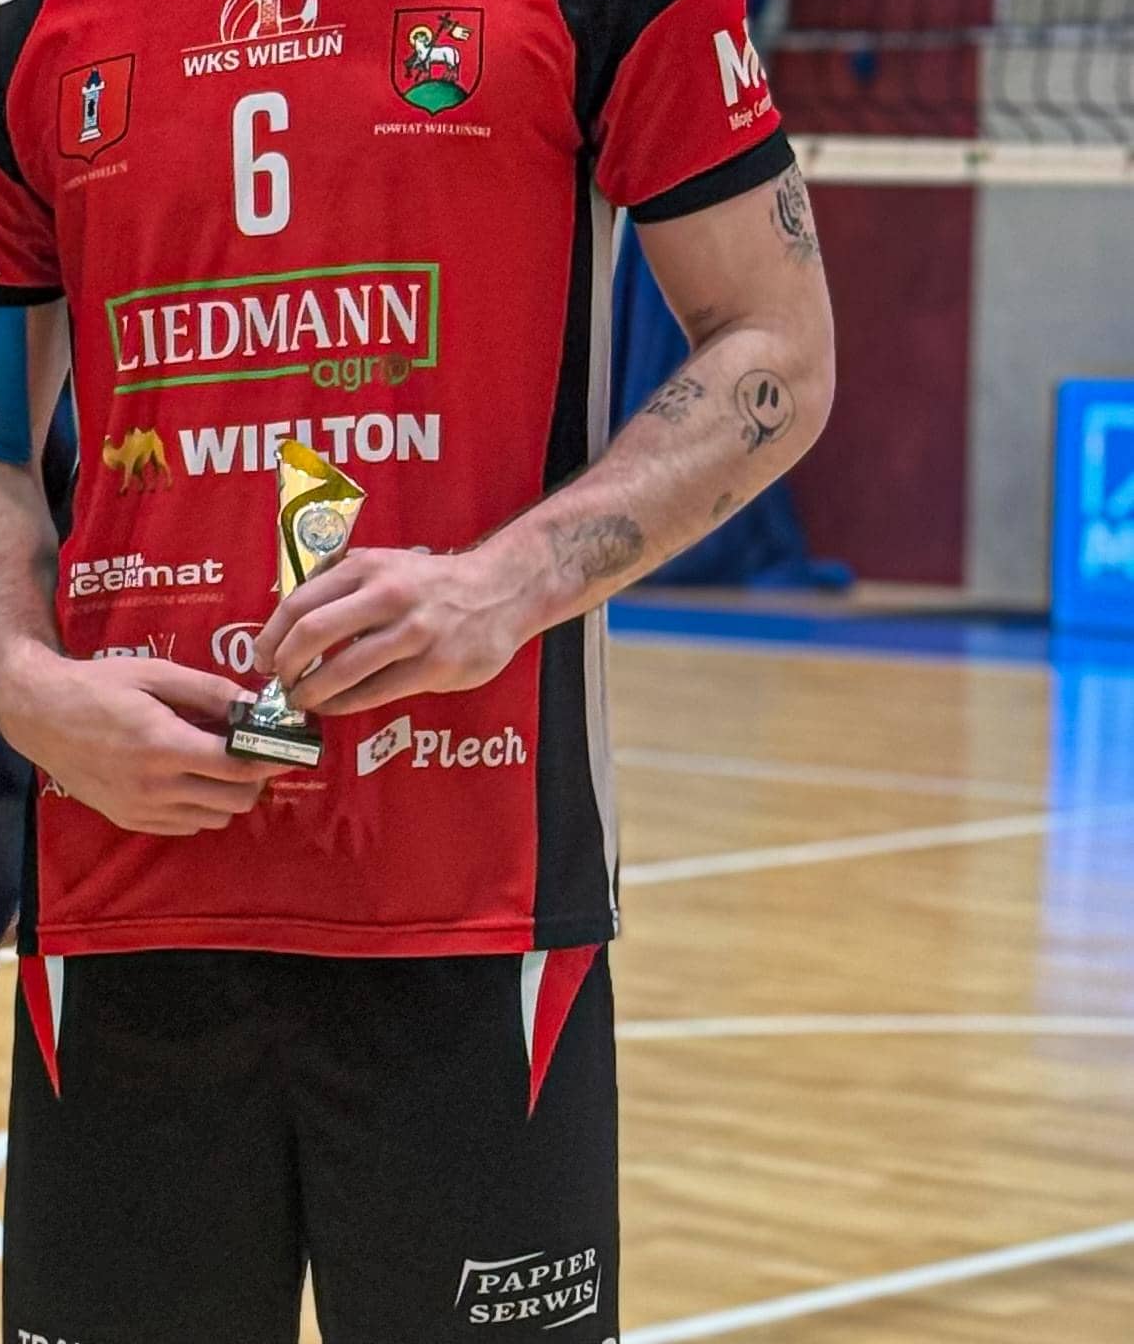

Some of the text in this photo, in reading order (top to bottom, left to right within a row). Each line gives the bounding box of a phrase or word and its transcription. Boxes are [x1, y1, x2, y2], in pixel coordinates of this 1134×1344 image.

[183, 30, 343, 77] WKS WIELUŃ
[233, 91, 291, 237] 6
[117, 284, 421, 373] LIEDMANN
[312, 354, 409, 393] agro
[411, 727, 527, 769] Plech
[477, 1247, 596, 1295] PAPIER
[469, 1279, 594, 1325] SERWIS
